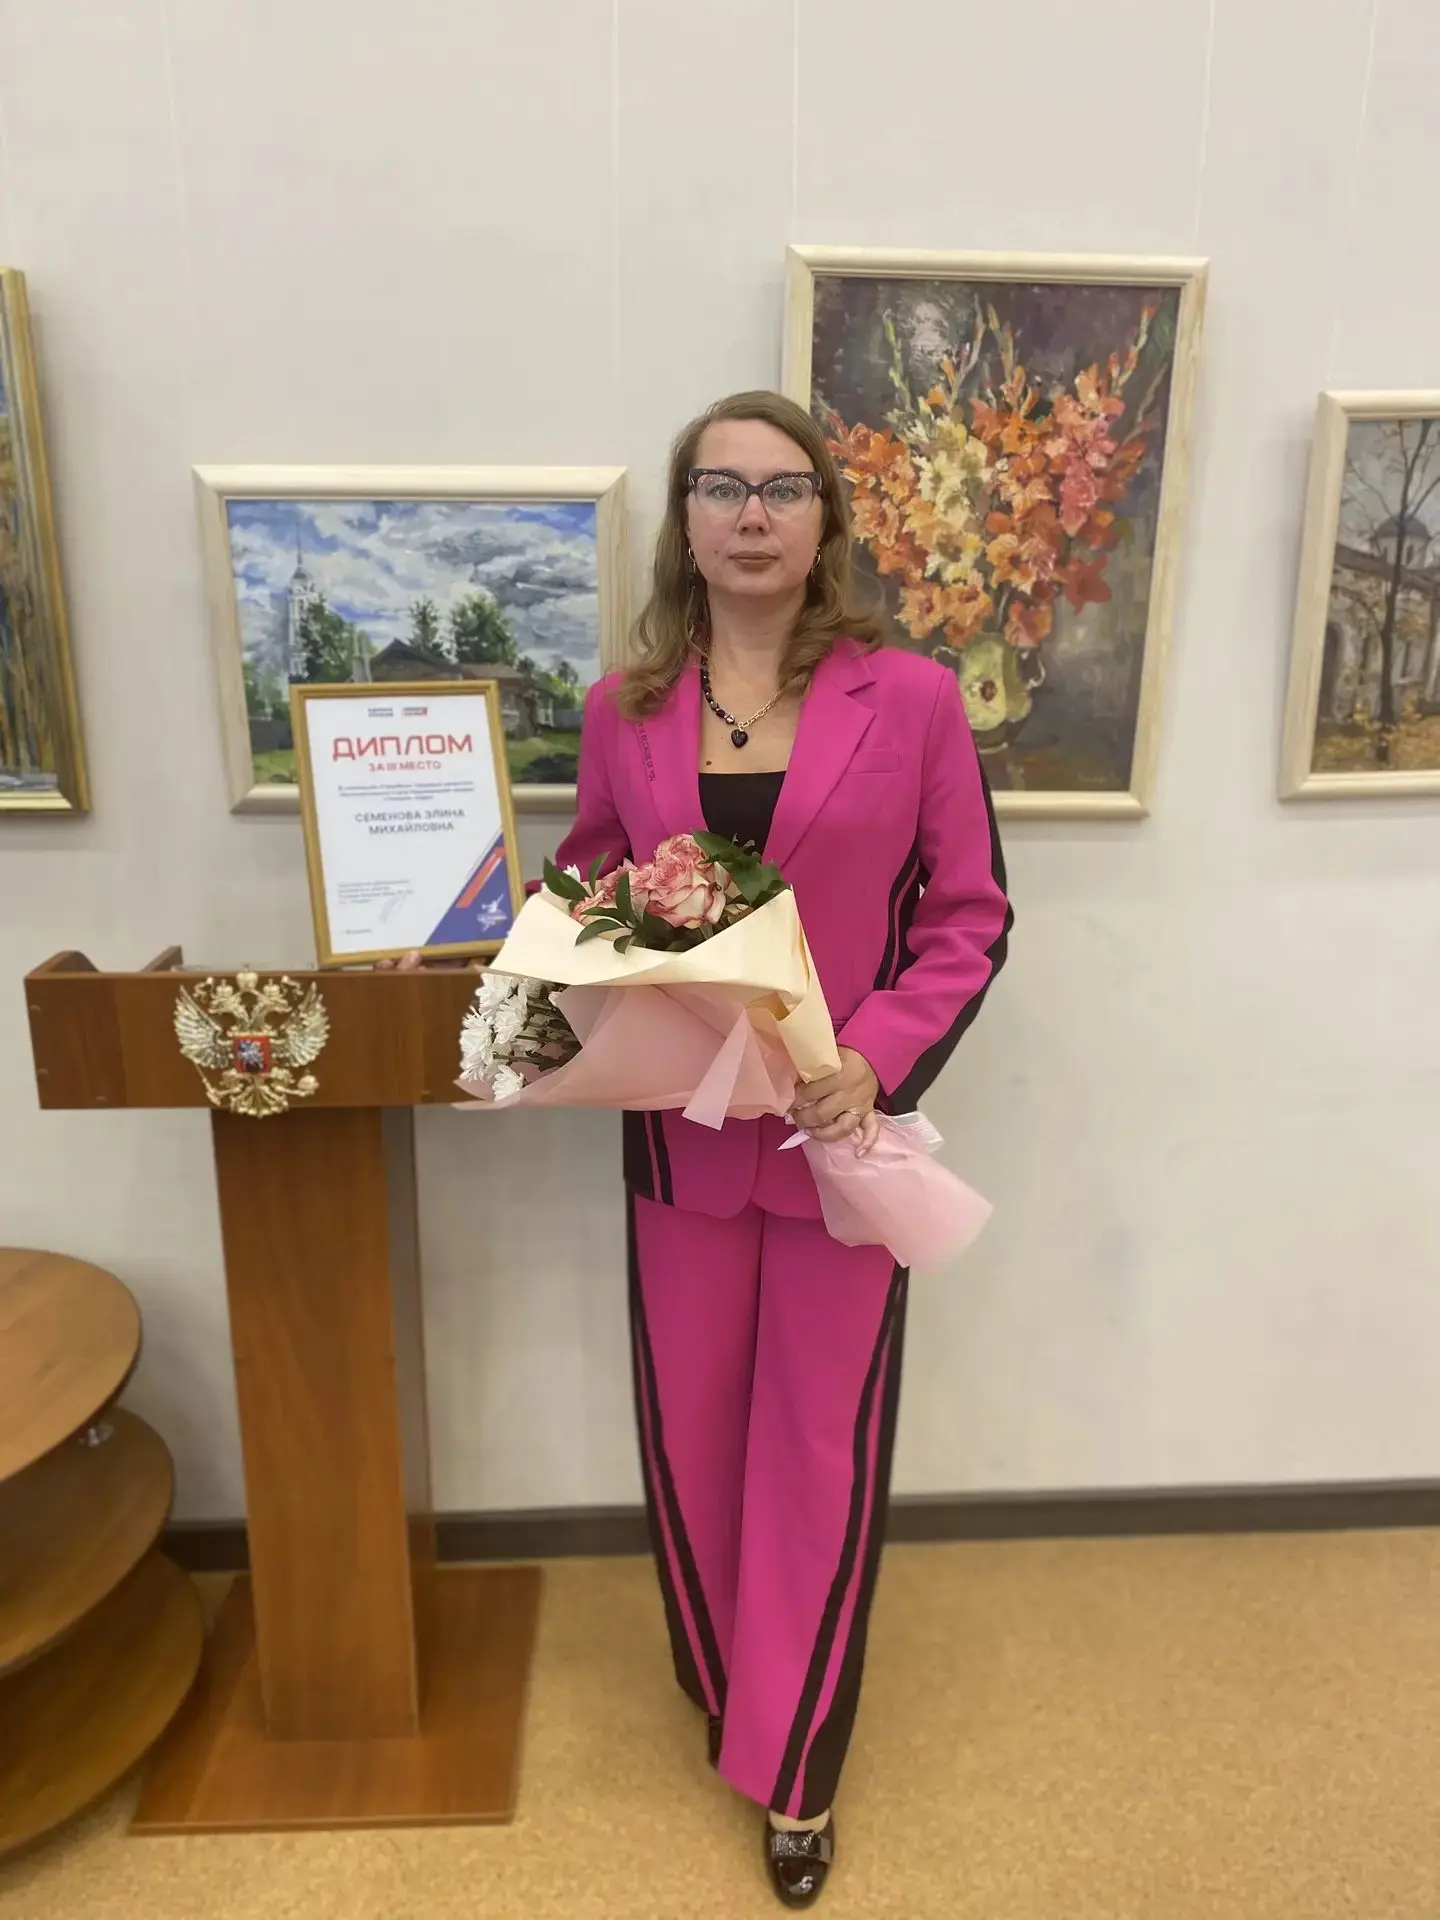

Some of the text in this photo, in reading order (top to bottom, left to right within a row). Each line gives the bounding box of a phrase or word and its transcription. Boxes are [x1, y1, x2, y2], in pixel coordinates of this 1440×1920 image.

[333, 734, 472, 761] ДИПЛОМ
[368, 762, 385, 772] ЗА
[399, 760, 441, 771] МЕСТО
[355, 808, 466, 822] СЕМЕНОВА ЭЛИНА
[369, 822, 454, 834] МИХАЙЛОВНА
